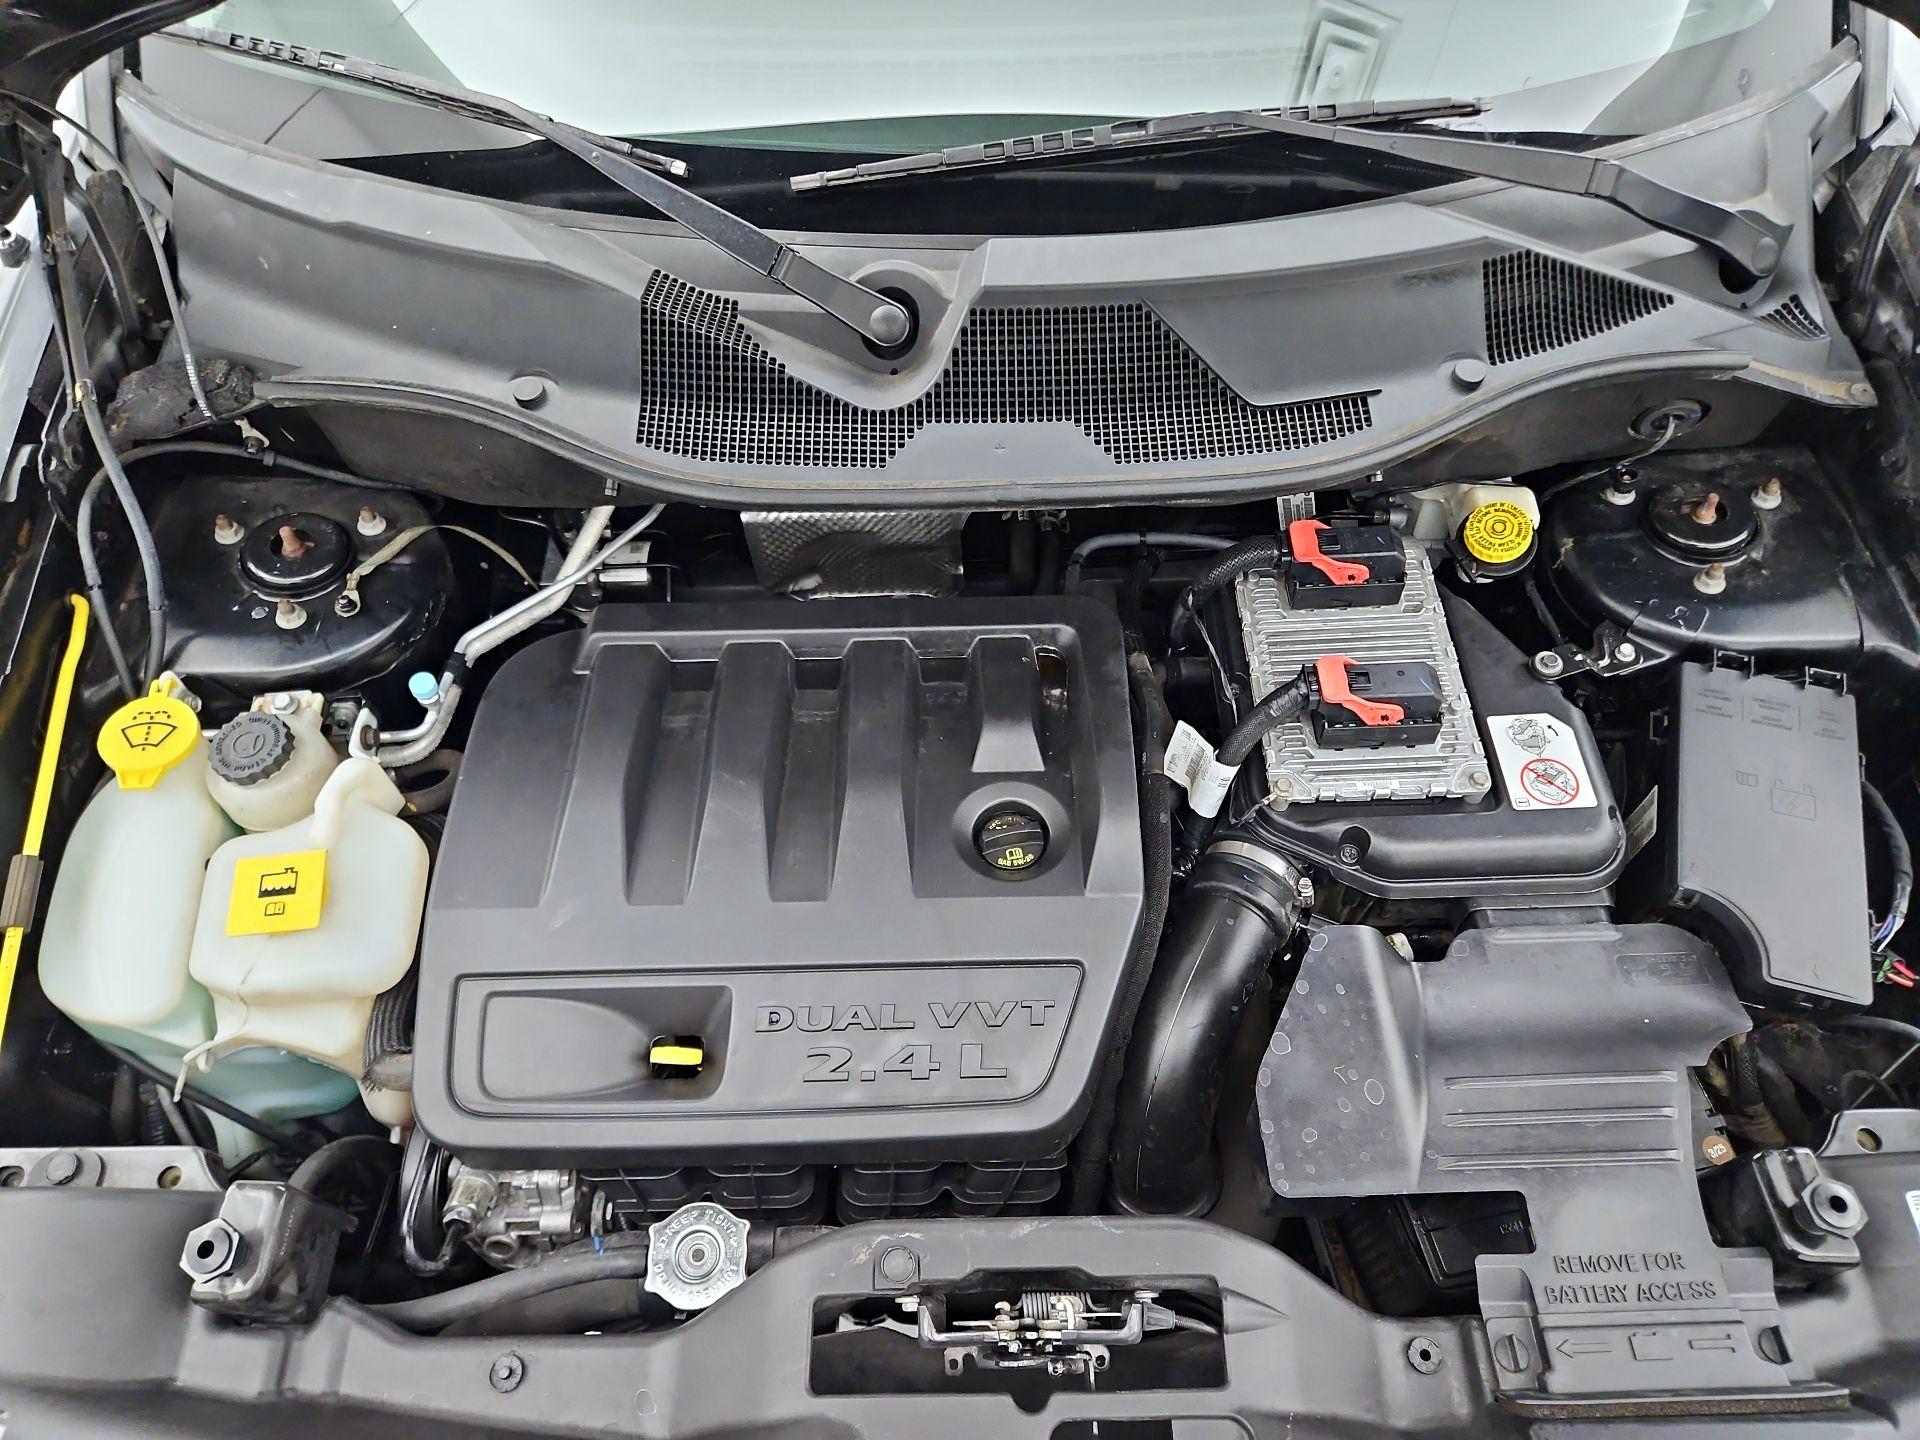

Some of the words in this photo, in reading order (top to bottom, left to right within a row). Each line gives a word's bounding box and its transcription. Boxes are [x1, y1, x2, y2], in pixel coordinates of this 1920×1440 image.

[997, 858, 1011, 866] SAE
[1012, 853, 1035, 866] 5W-20
[755, 1003, 915, 1033] DUAL
[928, 1000, 1056, 1029] VVT
[1707, 1143, 1727, 1158] 3/25
[665, 1210, 698, 1236] KEEP
[705, 1209, 737, 1235] TIGHT
[1553, 1253, 1639, 1274] REMOVE
[1643, 1252, 1686, 1271] FOR
[1544, 1283, 1628, 1305] BATTERY
[1637, 1280, 1717, 1303] ACCESS
